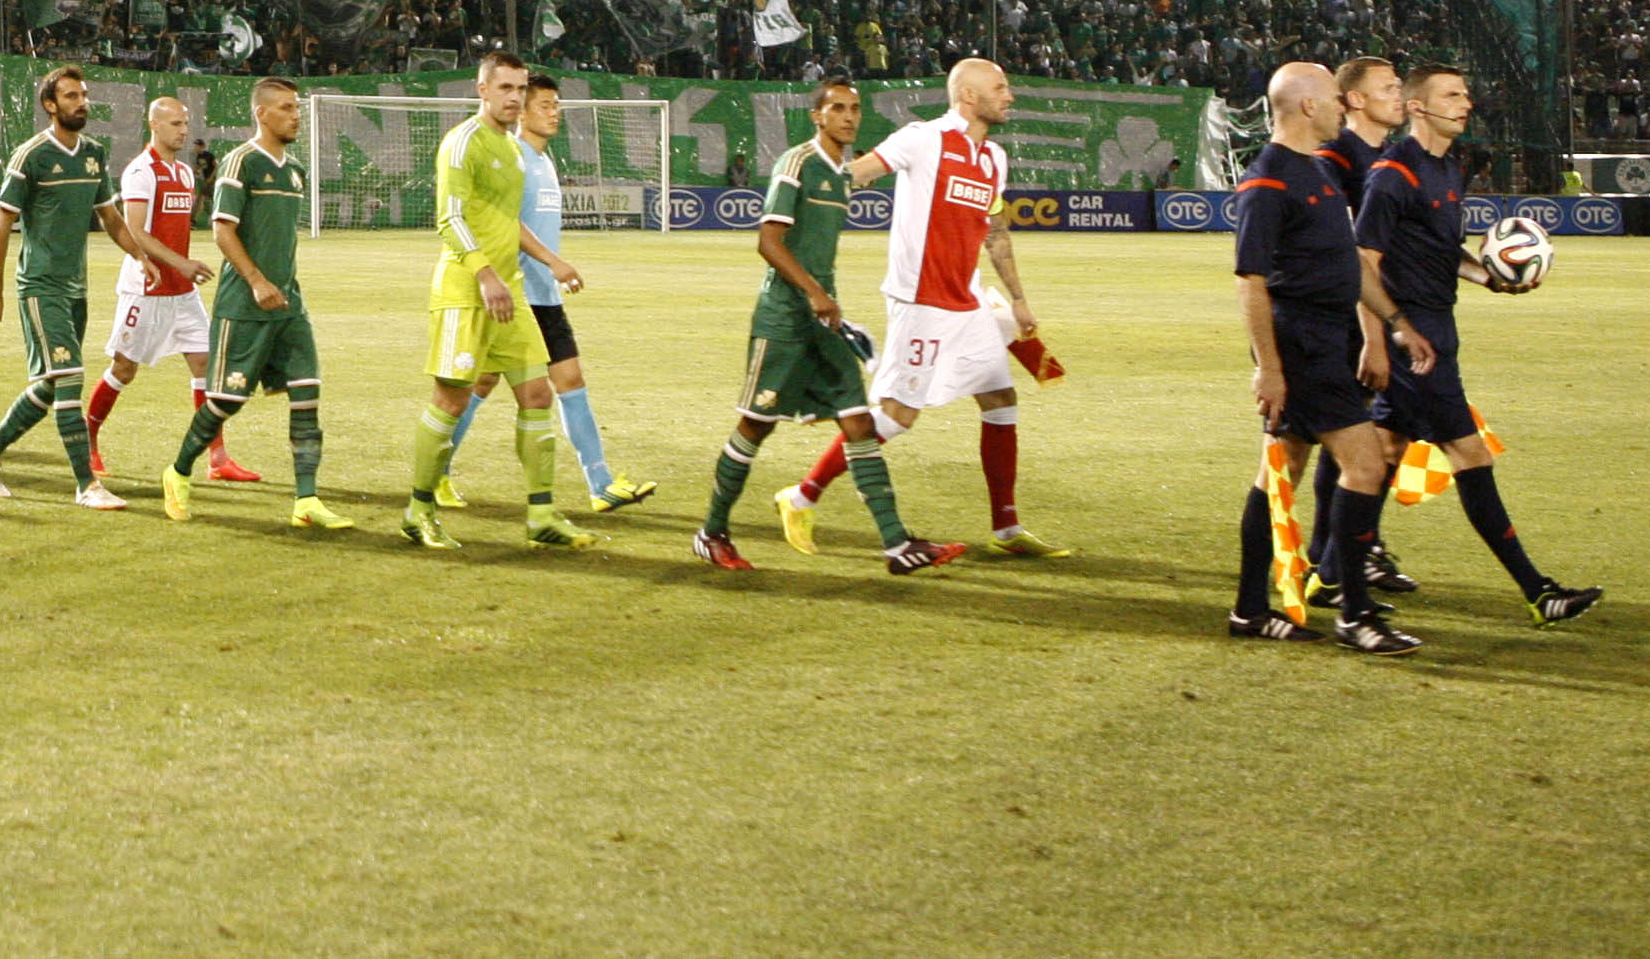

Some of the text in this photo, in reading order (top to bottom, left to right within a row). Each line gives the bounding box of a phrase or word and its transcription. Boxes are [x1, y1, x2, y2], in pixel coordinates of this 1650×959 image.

[167, 196, 191, 208] BASE
[952, 183, 991, 204] BASE
[1068, 195, 1103, 210] CAR
[719, 198, 762, 219] OTE
[849, 199, 890, 219] OTE
[1167, 201, 1207, 220] OTE
[1576, 207, 1616, 225] OTE
[1068, 213, 1134, 227] RENTAL
[125, 305, 140, 328] 6
[908, 338, 941, 367] 37
